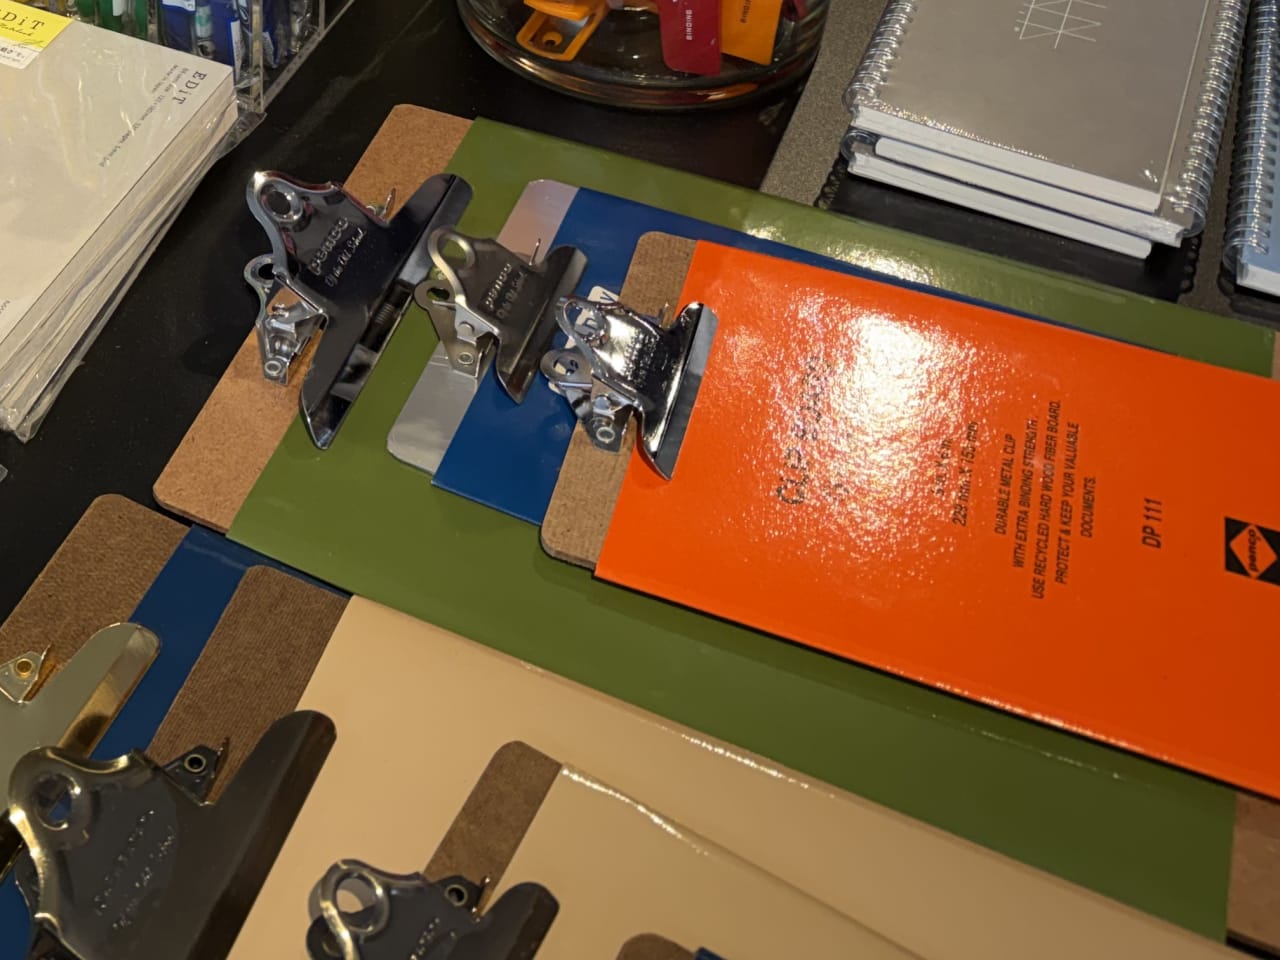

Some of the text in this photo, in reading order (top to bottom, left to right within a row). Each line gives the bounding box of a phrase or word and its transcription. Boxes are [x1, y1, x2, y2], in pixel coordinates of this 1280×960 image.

[172, 70, 208, 105] EDiT
[1063, 422, 1079, 470] VALUABLE
[994, 433, 1016, 535] DURABLE METAL CLIP
[1018, 469, 1034, 508] BINDING
[1031, 400, 1061, 600] USE RECYCLED HARD WOOD FIBER BOARD.
[1061, 472, 1075, 498] YOUR
[1015, 510, 1029, 542] EXTRA
[1059, 500, 1073, 526] KEEP
[1080, 476, 1096, 538] DOCUMENTS.
[1142, 498, 1163, 549] DP 111
[1013, 543, 1026, 568] WITH
[1055, 537, 1070, 584] PROTECT
[1248, 528, 1259, 572] penco
